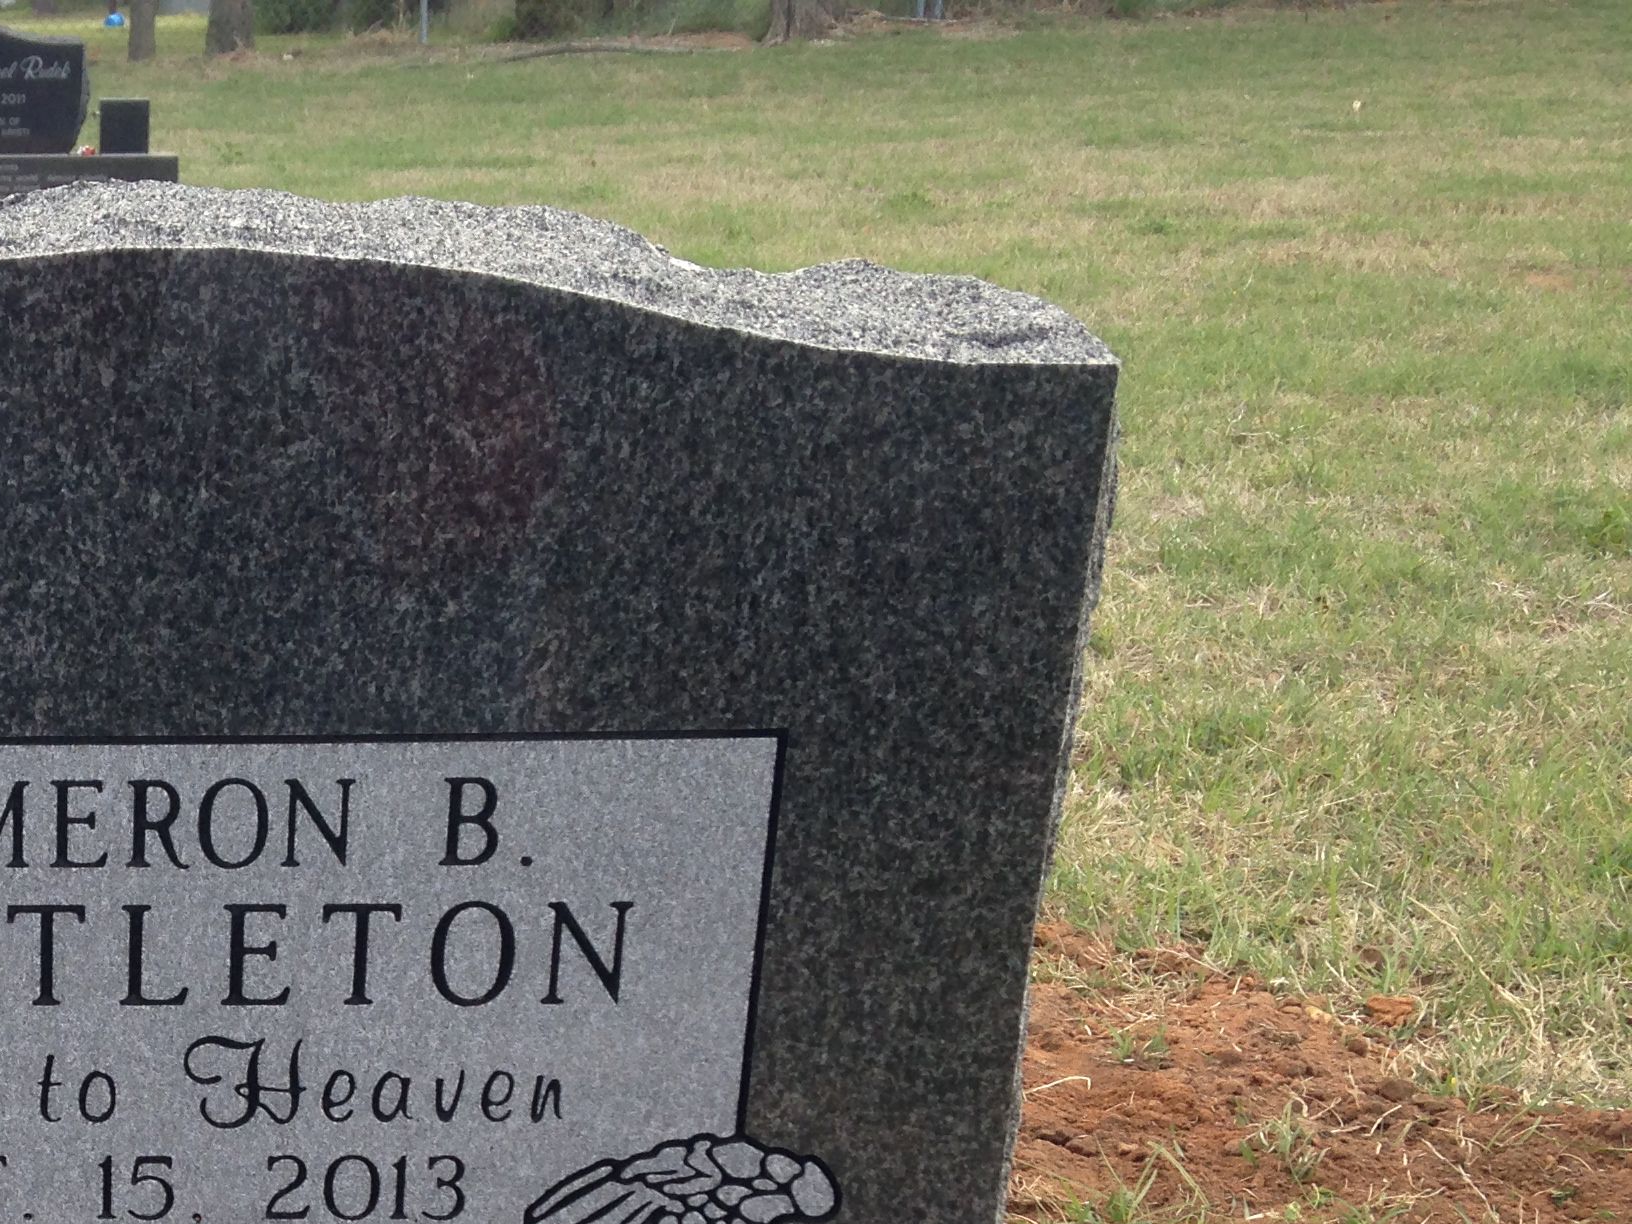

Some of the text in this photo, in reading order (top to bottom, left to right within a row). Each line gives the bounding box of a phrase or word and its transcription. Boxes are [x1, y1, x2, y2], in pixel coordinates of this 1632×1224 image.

[1, 93, 26, 105] 2011
[438, 776, 534, 868] B.
[37, 1054, 118, 1124] to
[183, 1035, 564, 1130] Heaven
[264, 1154, 466, 1222] 2013
